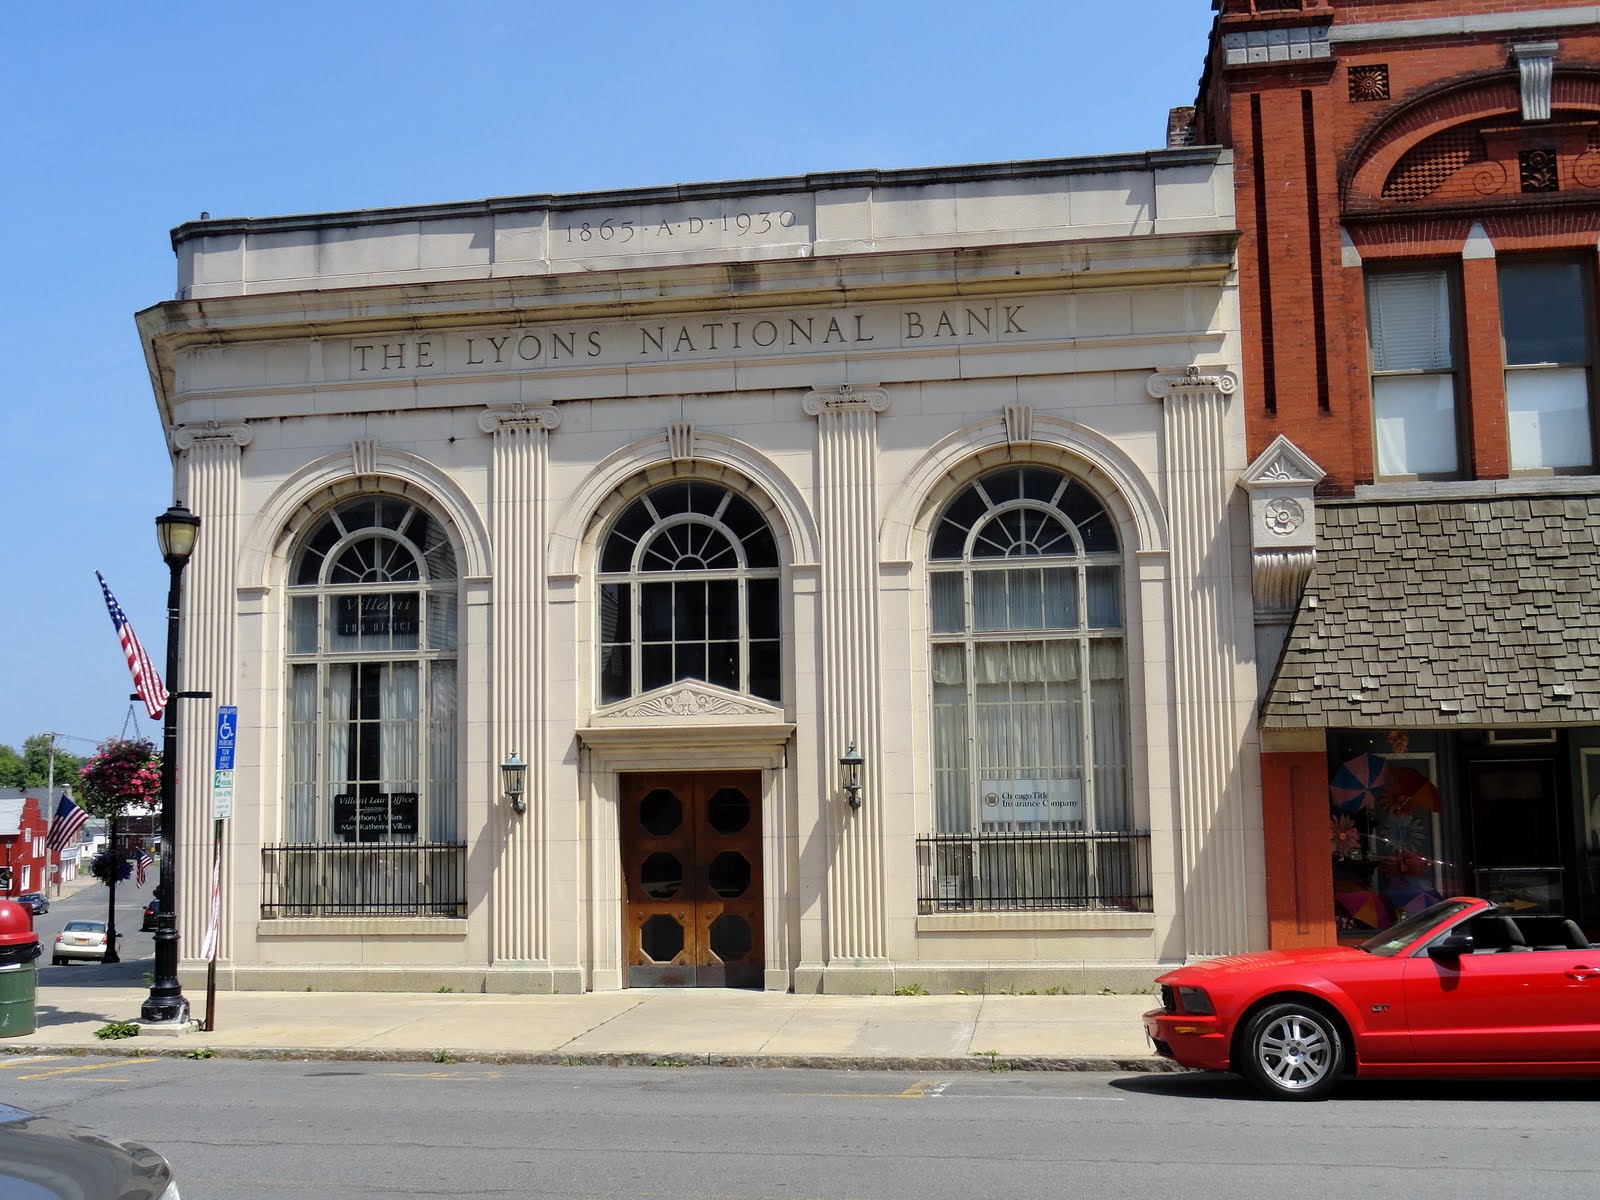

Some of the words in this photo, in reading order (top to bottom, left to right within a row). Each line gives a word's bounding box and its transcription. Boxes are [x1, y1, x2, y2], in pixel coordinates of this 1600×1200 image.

[566, 218, 635, 243] 1865
[722, 210, 797, 237] 1930
[354, 341, 434, 372] THE
[466, 331, 602, 365] LYONS
[640, 315, 875, 354] NATIONAL
[904, 305, 1028, 340] BANK
[1001, 792, 1032, 800] Chcago
[1042, 799, 1078, 808] Cmpany
